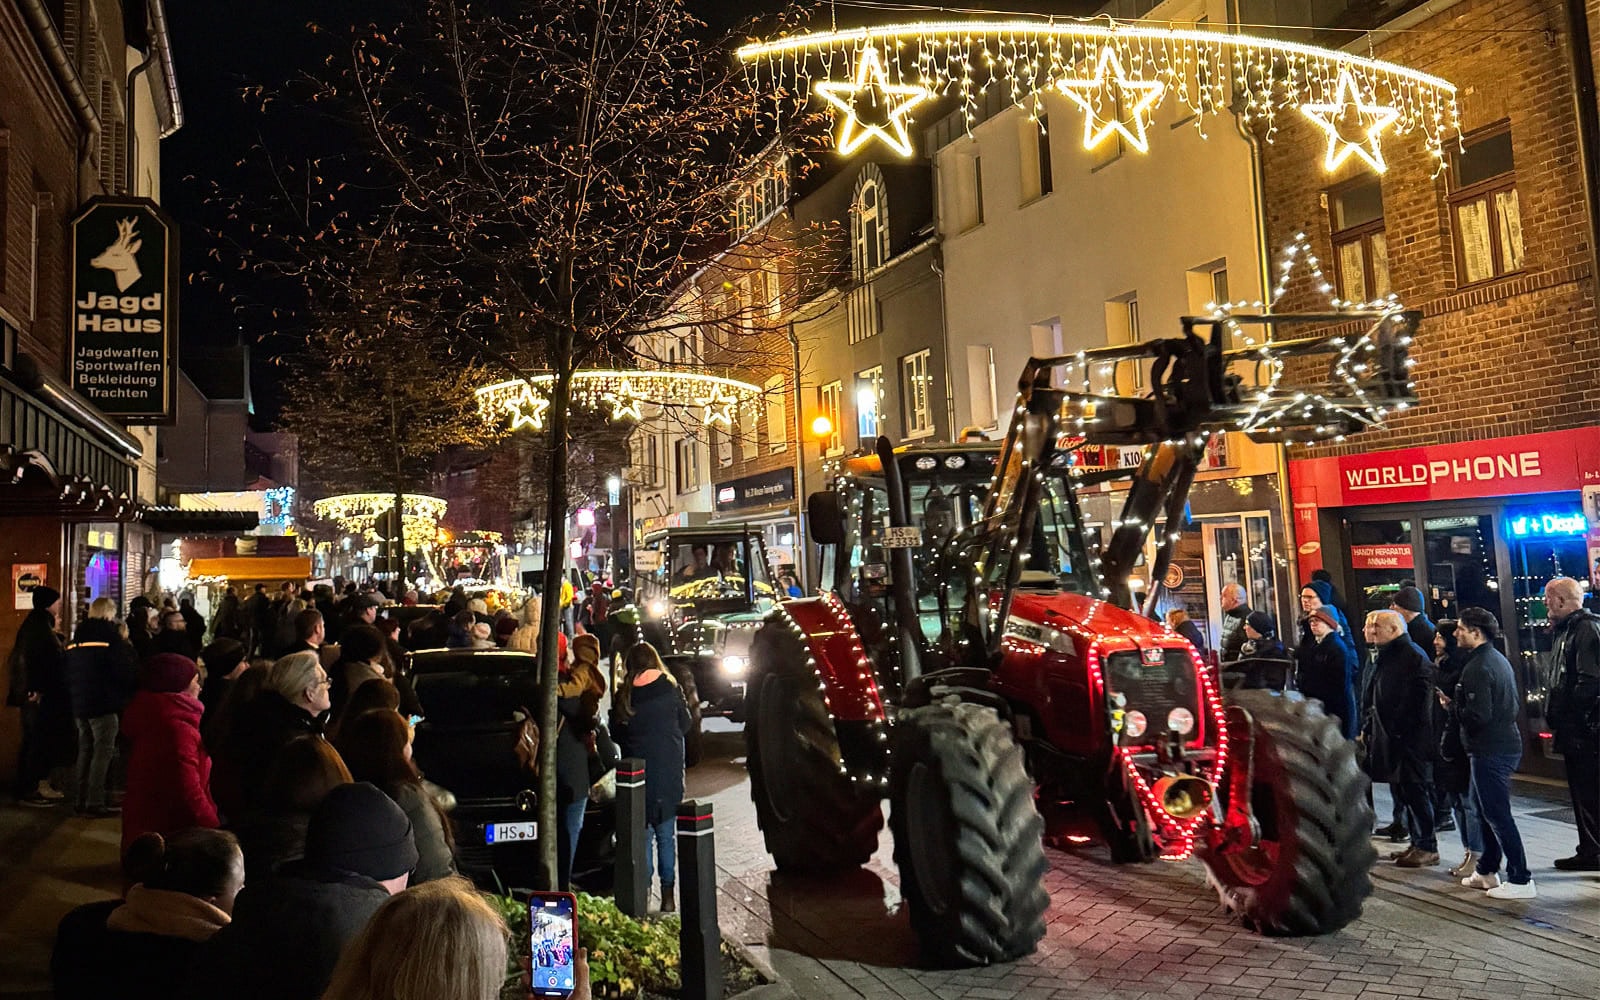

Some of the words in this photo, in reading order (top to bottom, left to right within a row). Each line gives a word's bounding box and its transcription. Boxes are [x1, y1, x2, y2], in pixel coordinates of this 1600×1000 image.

[77, 291, 162, 314] Jagd
[78, 314, 162, 333] Haus
[78, 347, 159, 359] Jagdwaffen
[76, 360, 161, 372] Sportwaffen
[79, 374, 157, 387] Bekleidung
[88, 387, 148, 398] Trachten
[1123, 451, 1143, 467] KIO
[1353, 548, 1374, 556] HANDY
[1375, 547, 1411, 556] REPARATUR
[500, 826, 517, 839] HS
[527, 825, 535, 838] J
